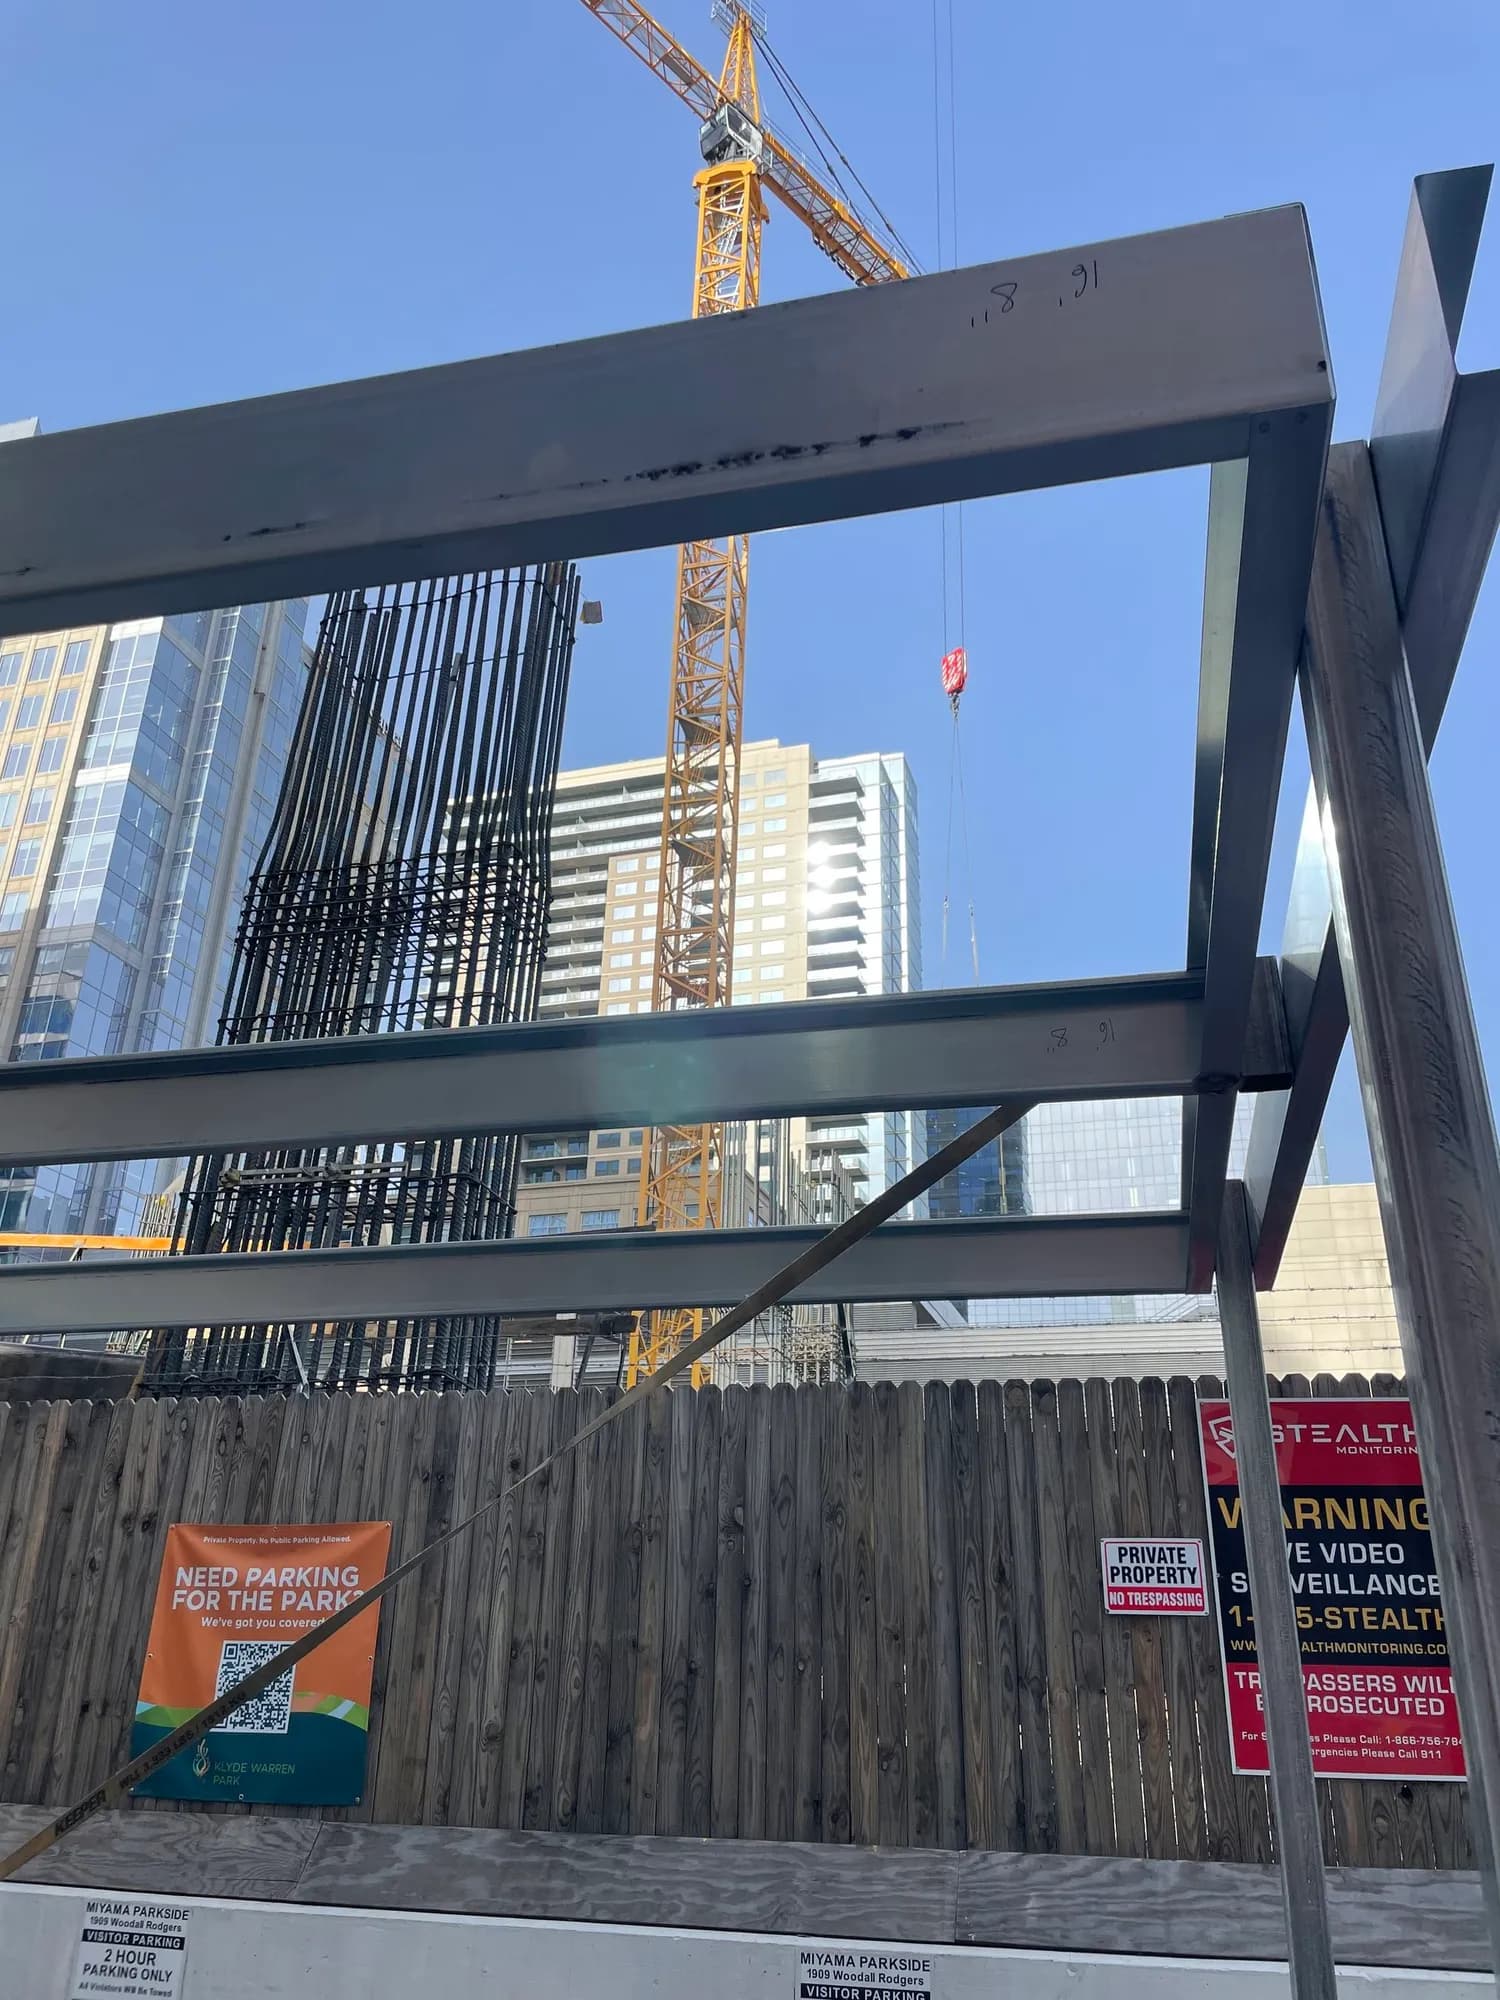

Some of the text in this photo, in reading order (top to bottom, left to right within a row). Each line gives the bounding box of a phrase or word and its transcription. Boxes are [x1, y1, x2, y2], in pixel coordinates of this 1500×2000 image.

[1272, 1423, 1416, 1443] STEALTH
[1336, 1446, 1418, 1454] MONITORIN
[203, 1536, 227, 1544] Private
[270, 1536, 291, 1544] Public
[293, 1535, 320, 1545] Parking
[1117, 1546, 1187, 1564] PRIVATE
[1319, 1542, 1405, 1564] VIDEO
[175, 1566, 360, 1588] NEED PARKING
[1110, 1565, 1198, 1585] PROPERTY
[1231, 1572, 1441, 1596] SVEILLANCE
[172, 1589, 221, 1611] FOR
[227, 1590, 274, 1612] THE
[1109, 1591, 1204, 1607] NO TRESPASSING
[201, 1617, 328, 1629] We've got you covered
[1234, 1671, 1396, 1693] TRASSERS
[1307, 1695, 1445, 1715] ROSECUTED
[1241, 1731, 1258, 1741] For
[1323, 1734, 1357, 1744] Please
[1359, 1735, 1383, 1745] Call:
[1385, 1736, 1463, 1746] 1-866-756-78
[1361, 1748, 1395, 1758] Please
[1398, 1749, 1418, 1759] Call
[1421, 1750, 1442, 1759] 911
[214, 1762, 296, 1774] KLYDE WARREN
[213, 1775, 240, 1785] PARK
[86, 1902, 190, 1921] MIYAMA PARKSIDE
[111, 1917, 144, 1929] Woodall
[146, 1920, 182, 1933] Rodgers
[86, 1930, 181, 1949] VISITOR PARKING
[104, 1948, 157, 1966] 2 HOUR
[800, 1951, 931, 1972] MIYAMA PARKSIDE
[82, 1963, 173, 1983] PARKING ONLY
[807, 1968, 925, 1987] 1909 Woodall Rodgers
[806, 1984, 926, 2000] VISITOR PARKING
